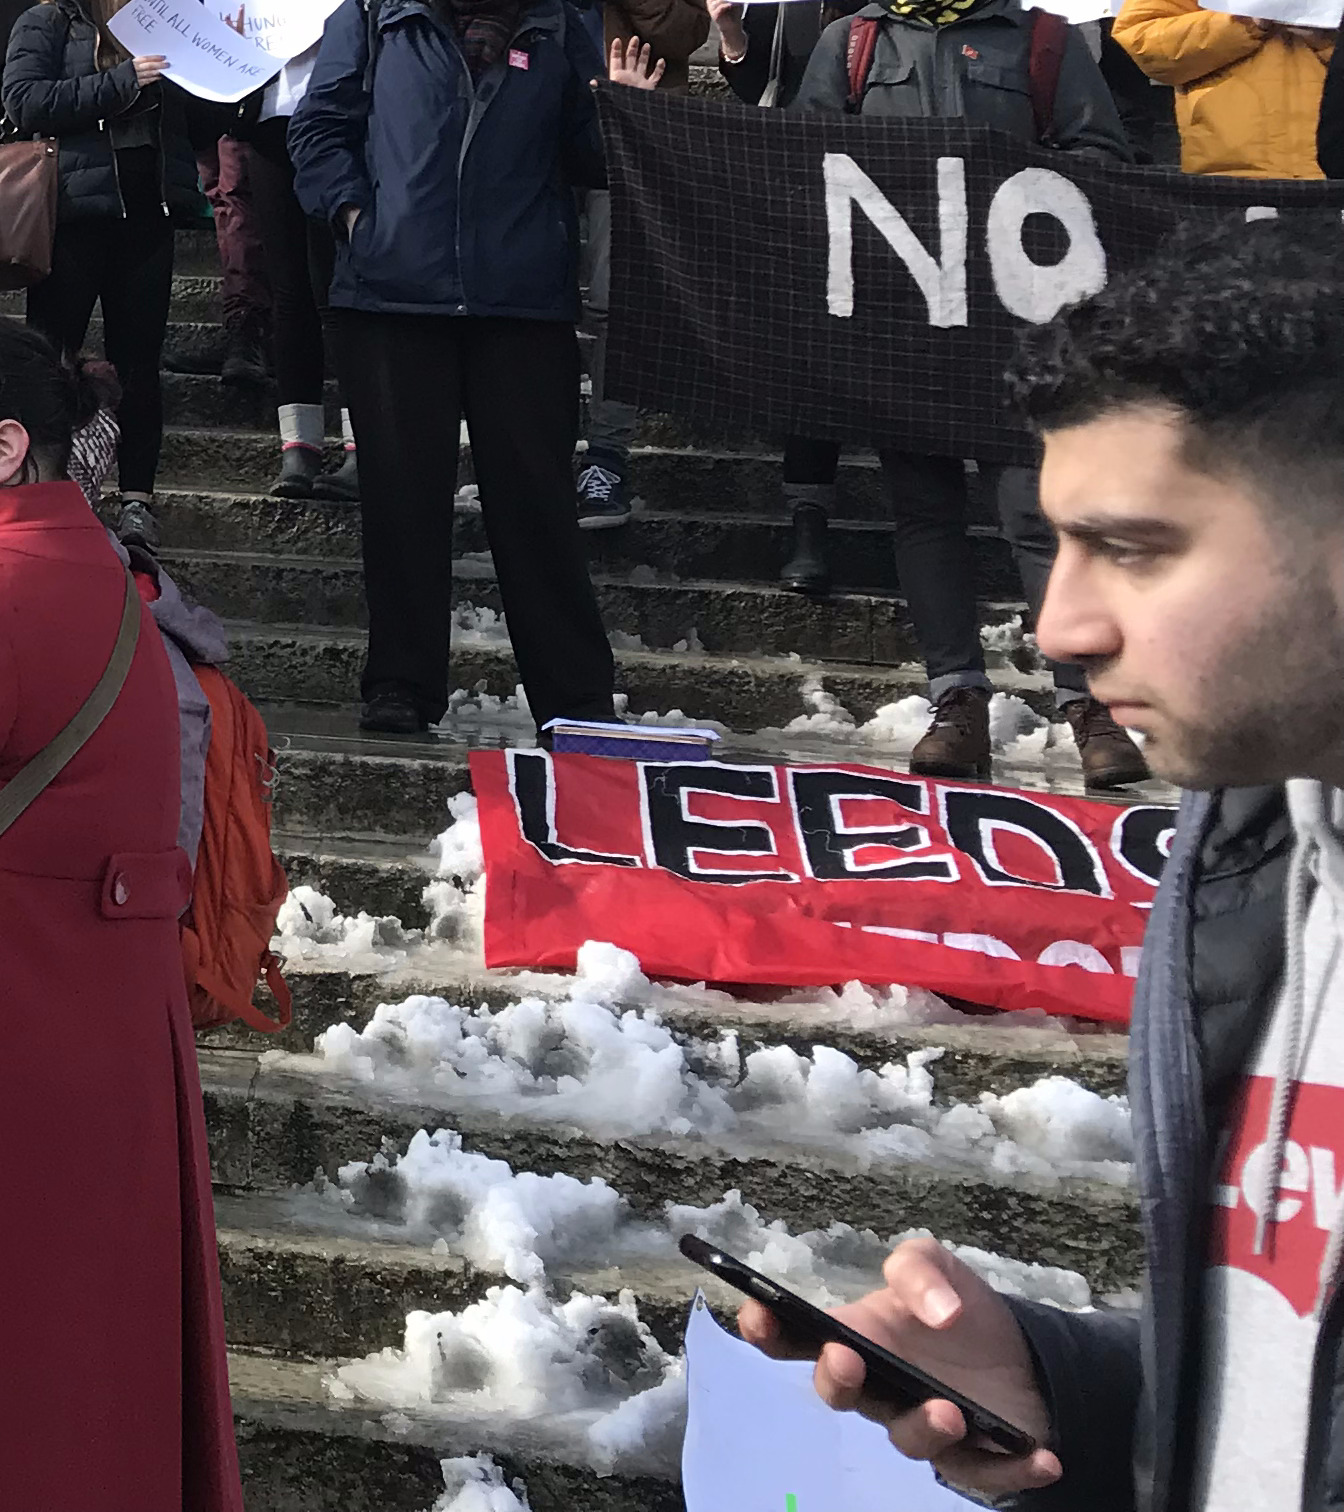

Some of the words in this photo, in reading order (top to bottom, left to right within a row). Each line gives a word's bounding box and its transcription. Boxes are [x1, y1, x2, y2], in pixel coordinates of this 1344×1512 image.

[166, 13, 191, 38] ALL
[191, 32, 239, 68] WOMEN
[823, 152, 1109, 328] NO
